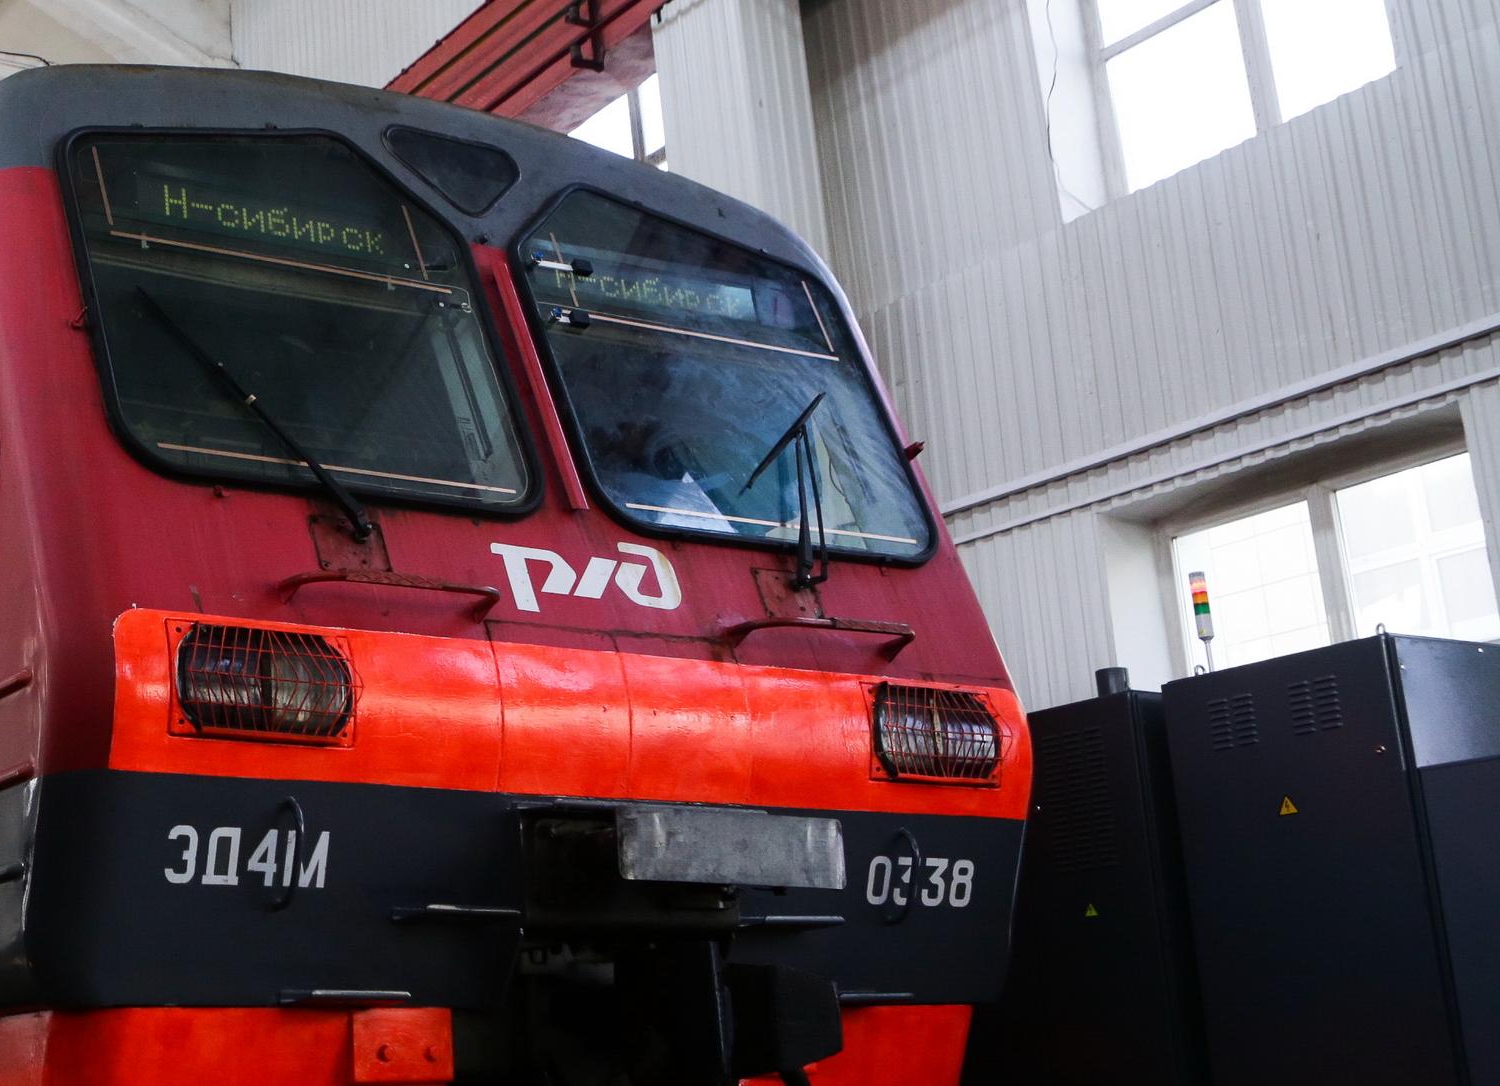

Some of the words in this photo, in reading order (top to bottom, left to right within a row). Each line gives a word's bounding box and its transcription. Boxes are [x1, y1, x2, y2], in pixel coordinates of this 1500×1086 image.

[163, 184, 384, 255] Н-сибирск
[490, 541, 683, 613] РЖД
[164, 824, 331, 889] ЭД4М
[866, 855, 975, 908] 0338
